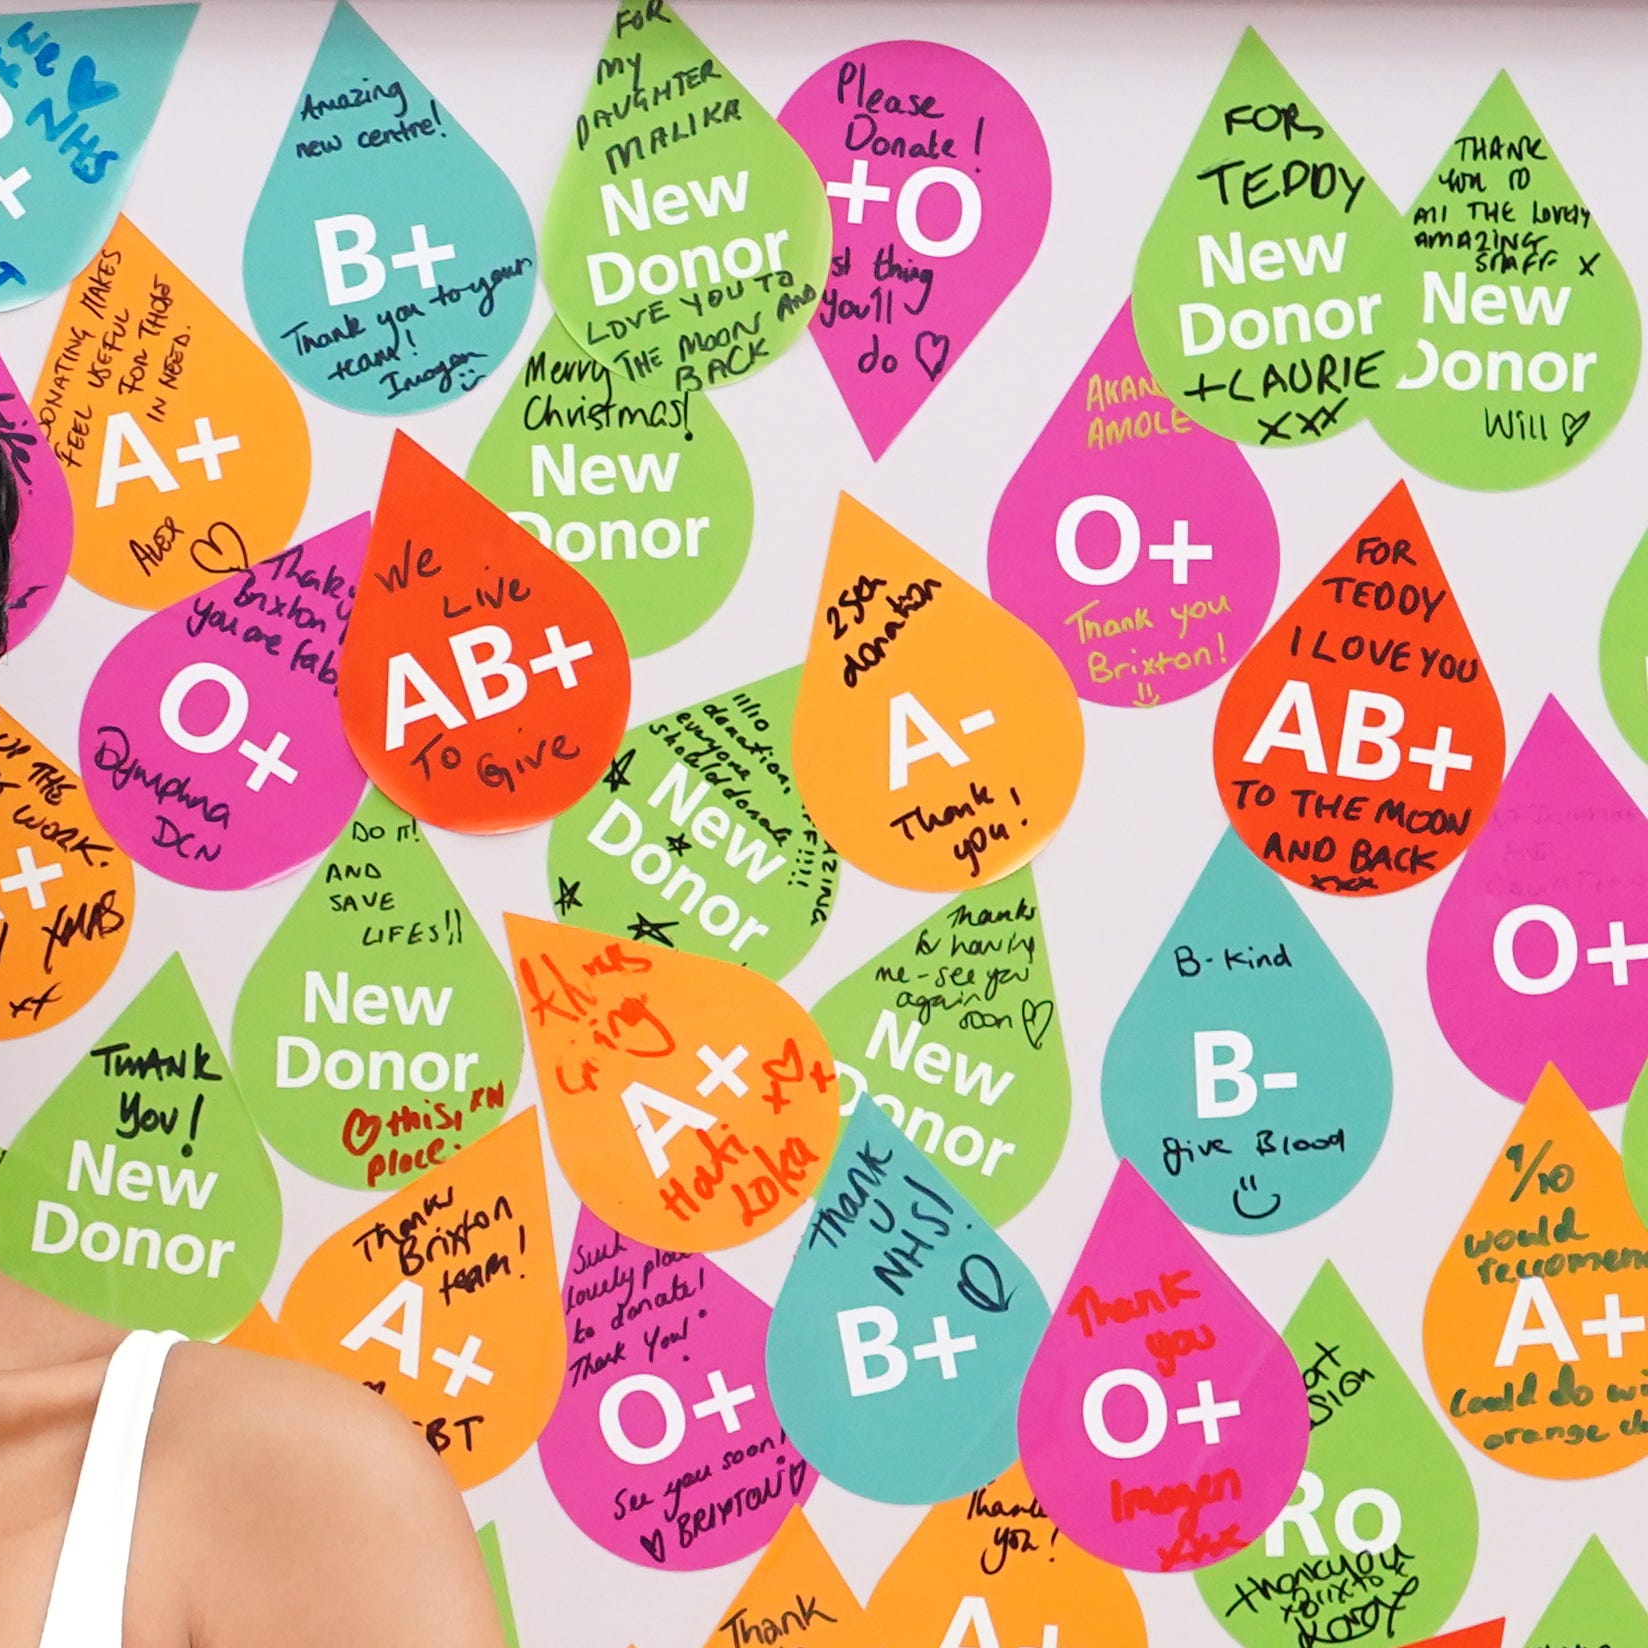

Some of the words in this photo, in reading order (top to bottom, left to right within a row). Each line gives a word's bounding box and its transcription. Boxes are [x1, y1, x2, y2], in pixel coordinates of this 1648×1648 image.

[299, 77, 406, 125] Amazing
[836, 62, 945, 120] Please
[599, 169, 749, 238] New
[1198, 158, 1365, 212] TEDDY
[313, 213, 457, 307] B+
[585, 229, 790, 307] Donor
[1198, 231, 1348, 290] New
[1177, 292, 1383, 357] Donor
[523, 391, 696, 443] Christmas!
[1483, 406, 1550, 443] Will
[93, 410, 242, 509] A+
[1053, 494, 1213, 586] O+
[1356, 538, 1416, 567] FOR
[1170, 596, 1233, 638] you
[1321, 577, 1447, 626] TEDDY
[383, 625, 595, 752] AB+
[1086, 636, 1229, 686] Brixton!
[478, 735, 581, 791] Give
[887, 690, 997, 791] A-
[1242, 679, 1474, 793] AB+
[326, 863, 381, 881] AND
[1263, 832, 1337, 864] AND
[1348, 840, 1437, 874] BACK
[329, 894, 397, 911] SAVE
[304, 973, 453, 1028] New
[276, 1036, 478, 1092] Donor
[1191, 1030, 1298, 1120] B-
[66, 1140, 218, 1210] New
[31, 1201, 236, 1279] Donor
[837, 1305, 977, 1398] B+
[1081, 1368, 1242, 1461] O+
